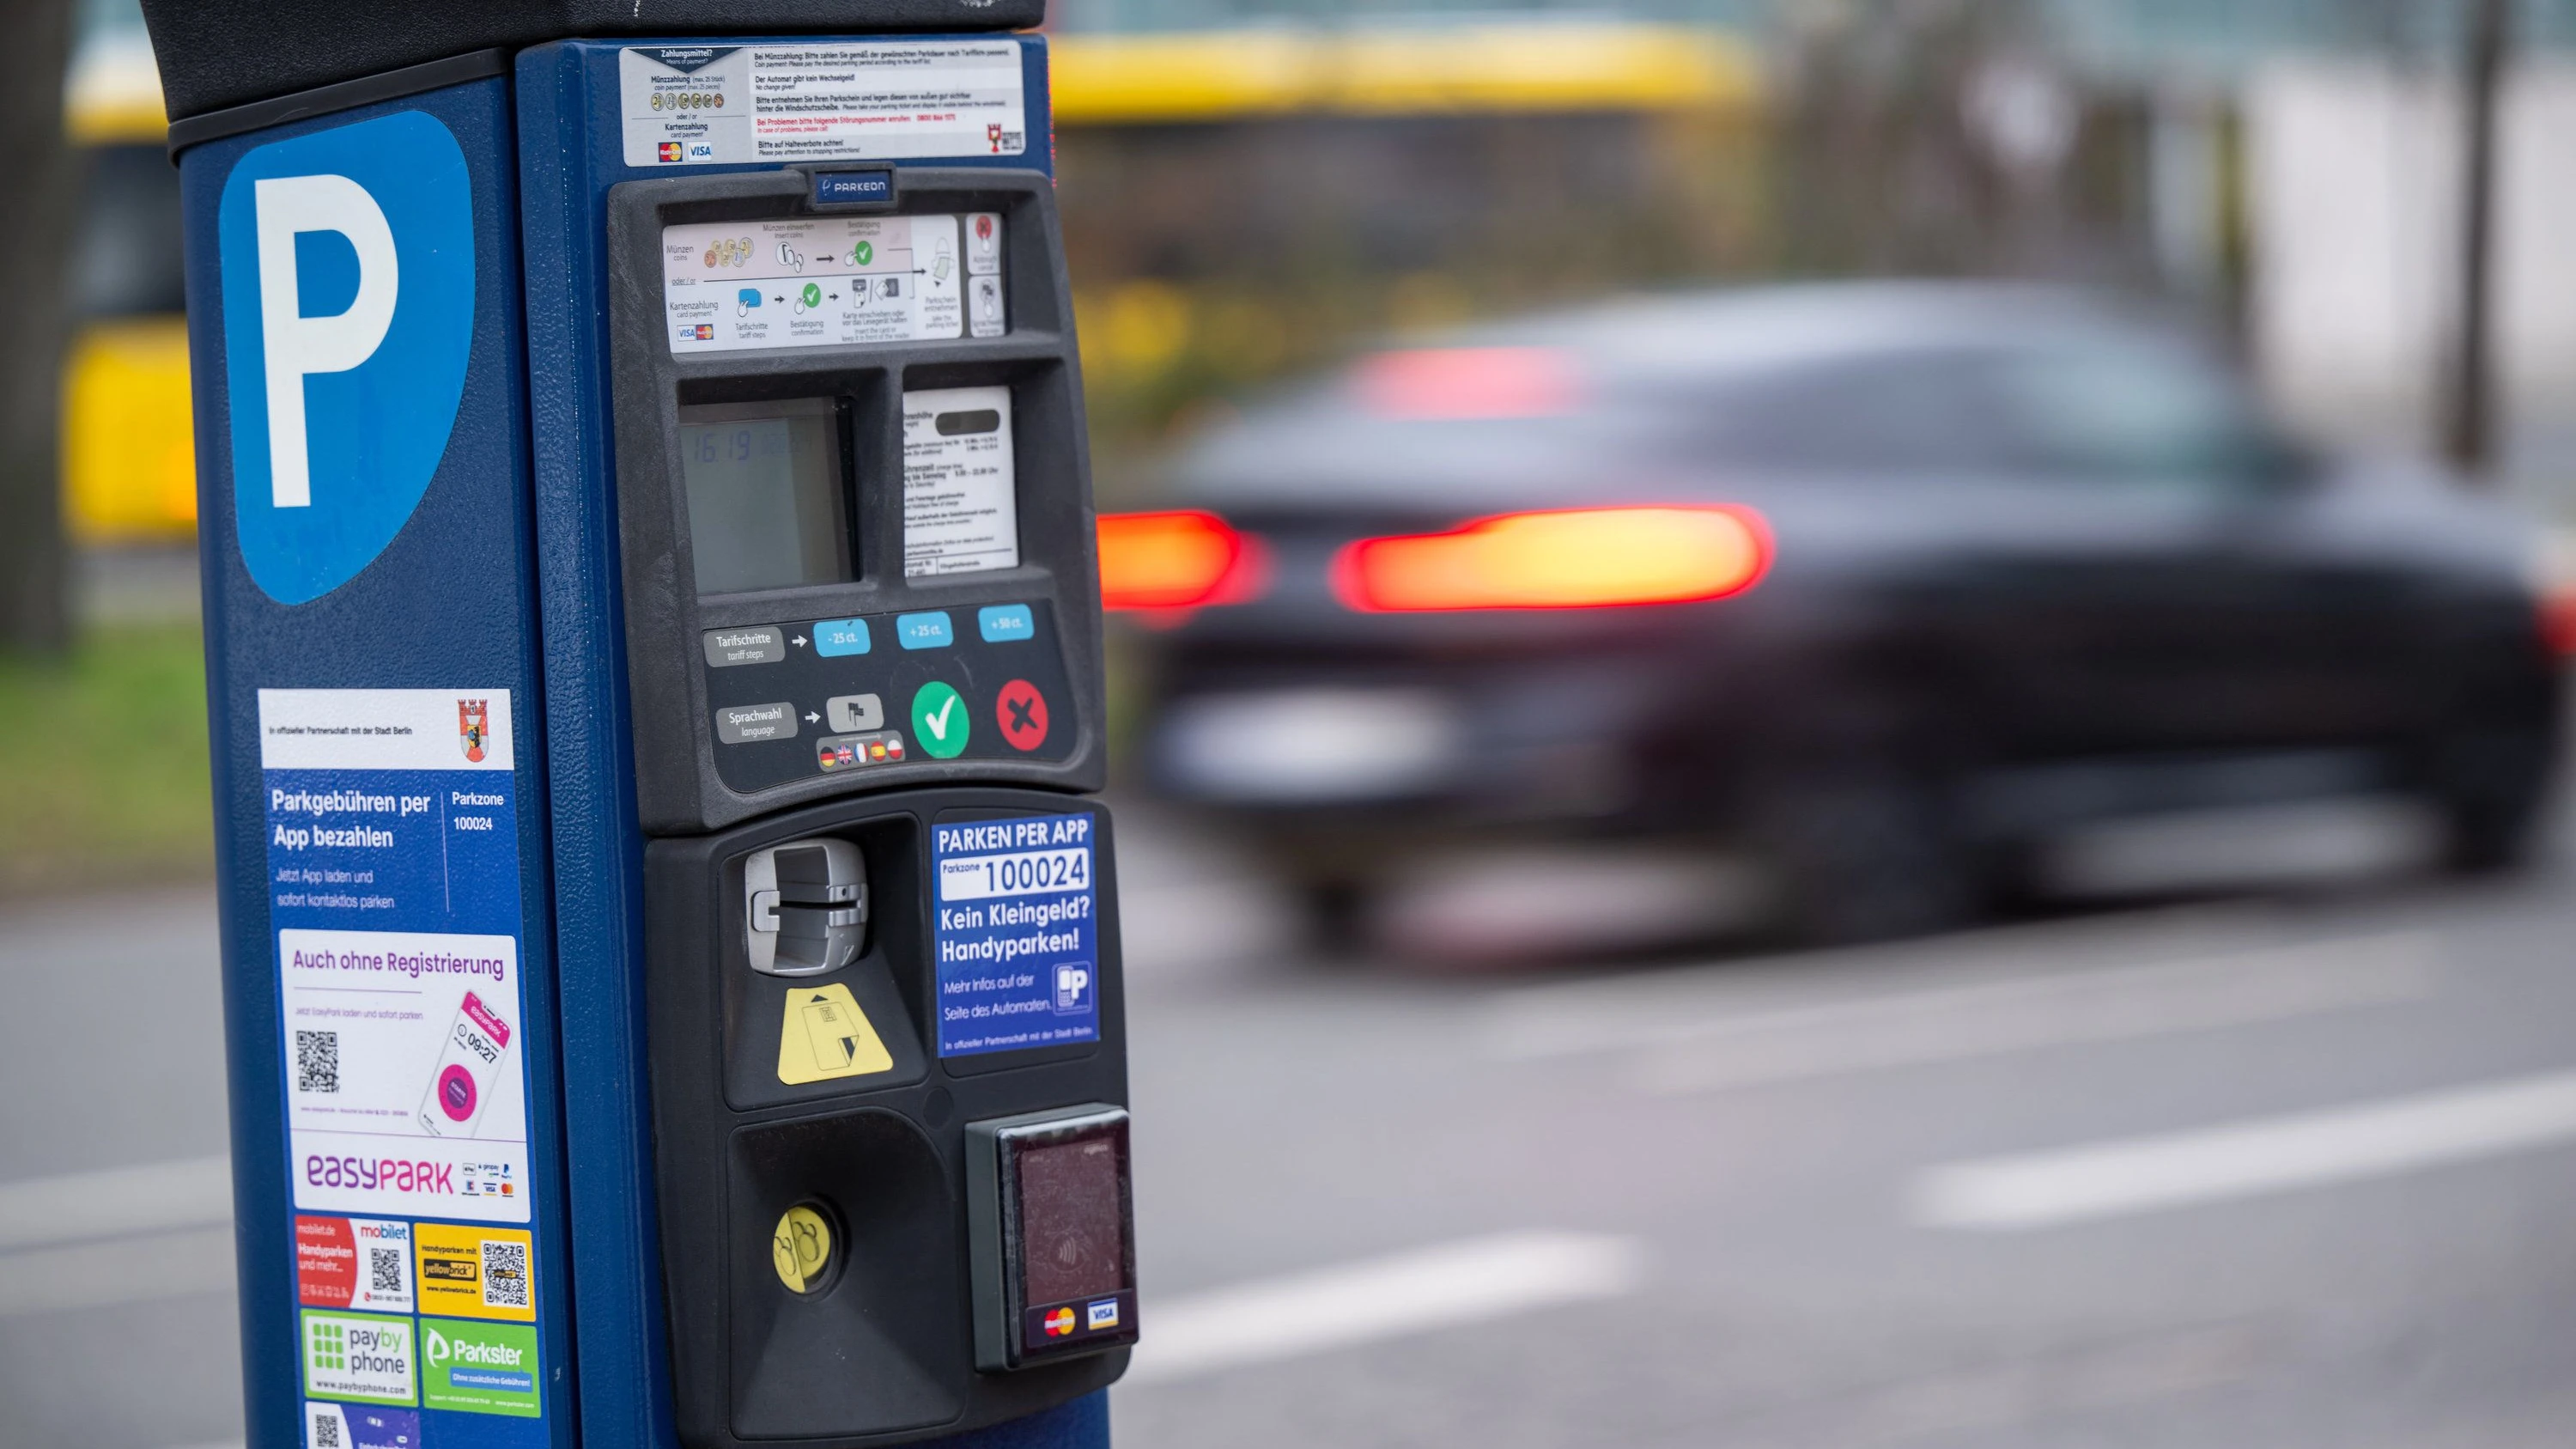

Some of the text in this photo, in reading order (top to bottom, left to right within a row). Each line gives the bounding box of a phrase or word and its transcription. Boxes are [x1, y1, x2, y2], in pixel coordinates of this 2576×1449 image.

[661, 49, 713, 58] Zahlungsmittel?
[793, 75, 805, 83] gibt
[873, 94, 889, 102] legen
[690, 146, 712, 155] VISA
[835, 181, 886, 192] PARKEON
[666, 246, 694, 254] Münzen
[670, 301, 719, 311] Kartenzahlung
[679, 328, 696, 338] VISA
[255, 174, 398, 508] P
[918, 625, 929, 636] 25
[716, 634, 771, 648] Tarifschritte
[833, 633, 845, 644] 25
[846, 632, 858, 643] ct.
[727, 650, 764, 661] tariff steps
[729, 708, 782, 726] Sprachwahl
[374, 727, 392, 735] Stadt
[393, 727, 413, 735] Berlin
[742, 726, 775, 738] language
[271, 788, 431, 817] Parkgebühren per
[452, 792, 504, 806] Parkzone
[453, 817, 493, 831] 100024
[274, 825, 393, 851] App bezahlen
[939, 819, 1089, 853] PARKEN PER APP
[276, 868, 374, 885] Jetzt App laden und
[943, 854, 1084, 892] Parkzone 100024
[277, 892, 395, 910] sofort kontaktlos parken
[941, 896, 1090, 931] Kein Kleingeld?
[942, 928, 1079, 963] Handyparken!
[294, 949, 504, 982] Auch ohne Registrierung
[945, 974, 1035, 995] Mehr Infos auf der
[945, 1006, 969, 1020] Seite
[971, 1004, 992, 1018] des
[992, 999, 1052, 1015] Automaten.
[467, 1033, 497, 1064] 09:27
[361, 1223, 407, 1240] mobilet
[298, 1243, 354, 1259] Handyparken
[422, 1245, 465, 1255] Handyparken
[425, 1263, 468, 1275] yellowbrick
[1093, 1308, 1114, 1319] VISA
[349, 1326, 403, 1354] payby
[453, 1339, 523, 1366] Parkster
[351, 1351, 405, 1375] phone
[316, 1380, 406, 1394] www.paybyphone.com
